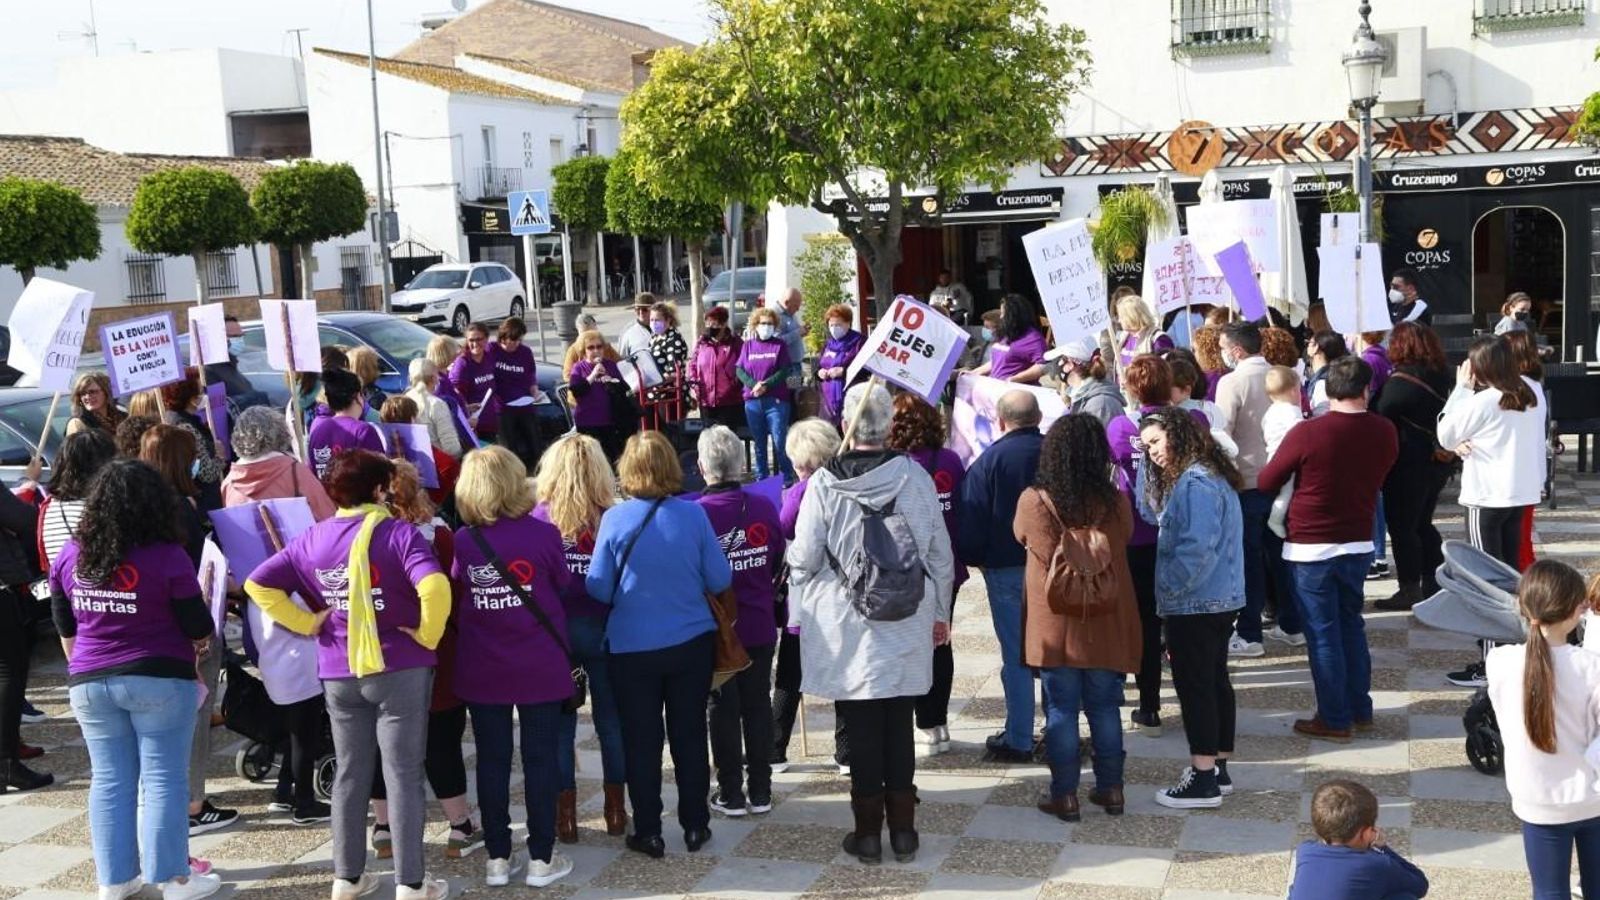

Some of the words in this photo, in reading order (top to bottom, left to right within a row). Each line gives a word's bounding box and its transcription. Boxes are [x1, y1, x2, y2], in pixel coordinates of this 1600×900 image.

[1186, 127, 1217, 165] 7
[1277, 119, 1449, 159] COAS
[1505, 164, 1546, 178] COPAS
[1293, 181, 1342, 192] uzcampo
[1391, 173, 1458, 186] Cruzcampo
[1224, 183, 1250, 194] OPAS
[996, 193, 1053, 206] Cruzcampo
[1405, 250, 1451, 265] COPAS
[112, 331, 124, 342] LA
[889, 327, 935, 359] EJES
[112, 346, 126, 356] ES
[128, 341, 141, 353] LA
[129, 366, 138, 374] LA
[729, 555, 768, 571] artas
[74, 596, 138, 614] #Hartas
[473, 593, 522, 610] #Harta
